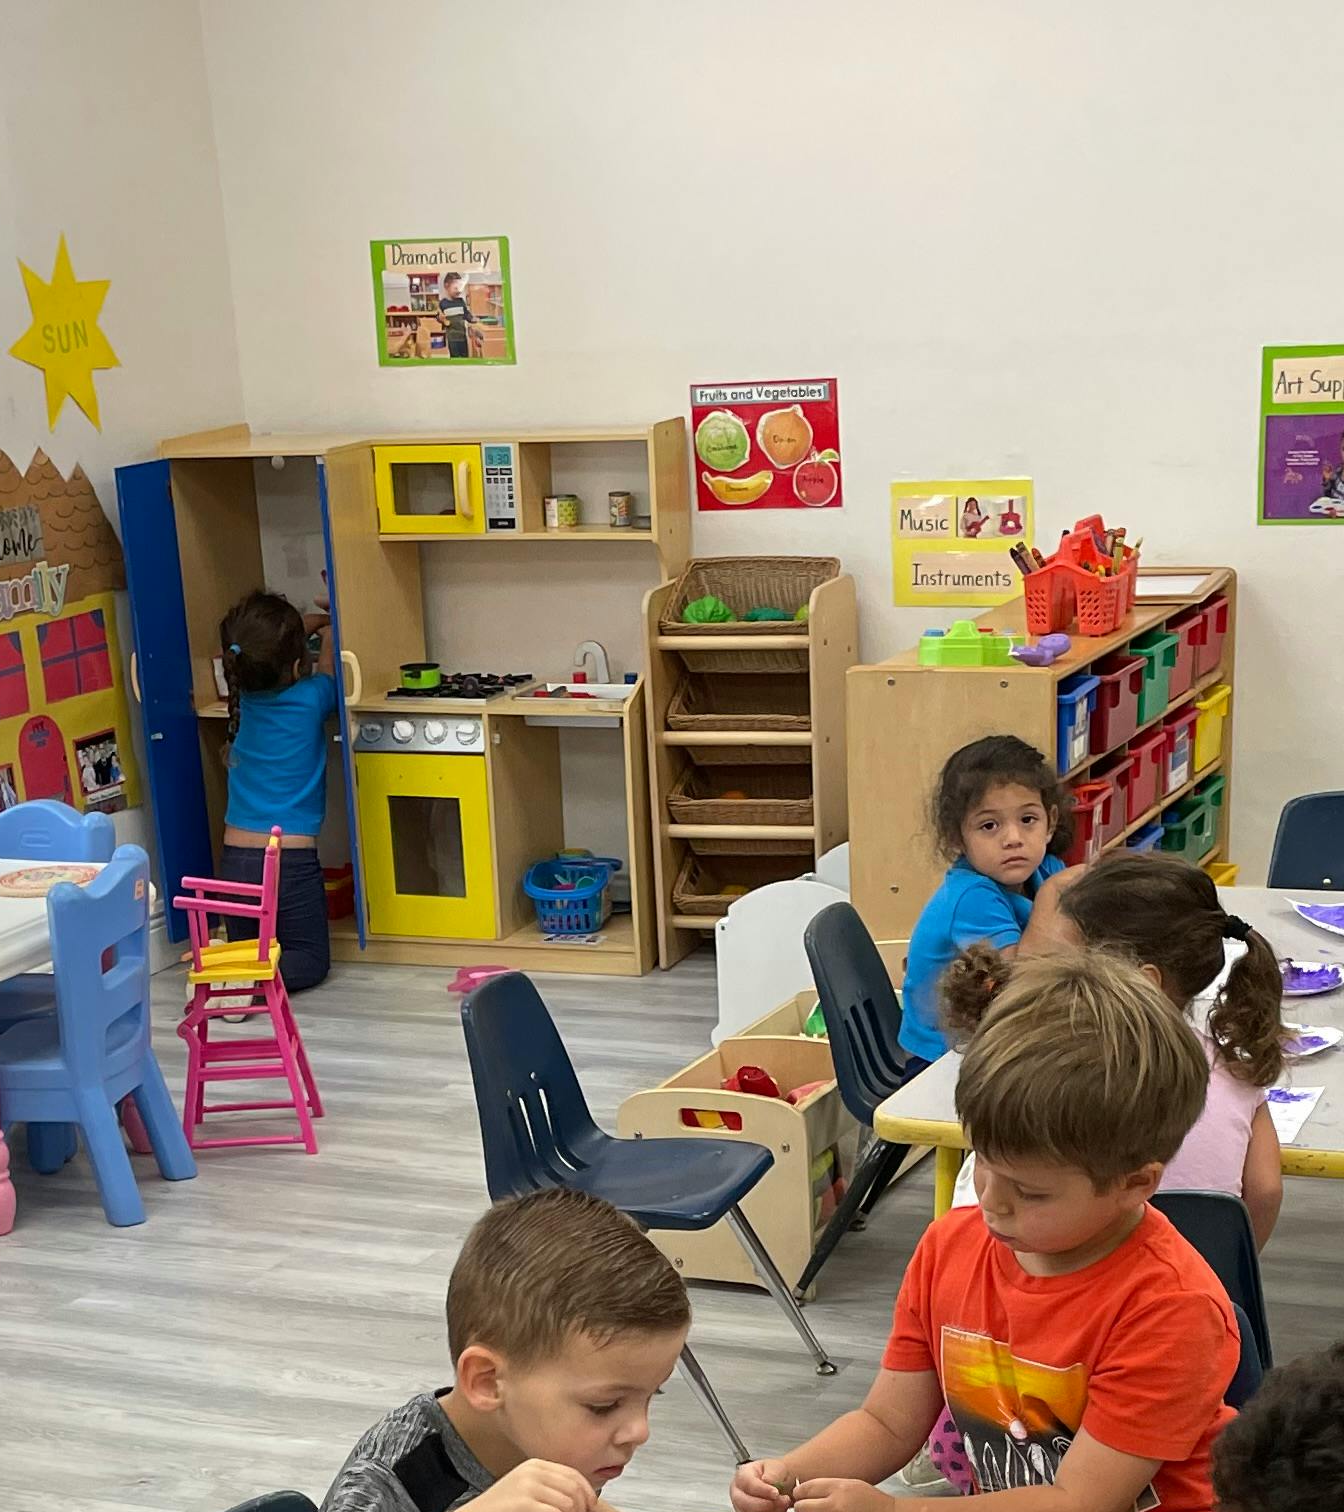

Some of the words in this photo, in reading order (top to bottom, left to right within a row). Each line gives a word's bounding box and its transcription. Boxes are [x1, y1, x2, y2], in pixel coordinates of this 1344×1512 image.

[391, 243, 458, 267] Dramatic
[460, 241, 491, 268] Play
[41, 319, 90, 353] SUN
[699, 390, 728, 402] Fruits
[730, 389, 754, 401] and
[755, 386, 823, 401] Vegetables
[1274, 371, 1305, 395] Art
[899, 508, 950, 533] Music
[911, 562, 1012, 588] Instruments
